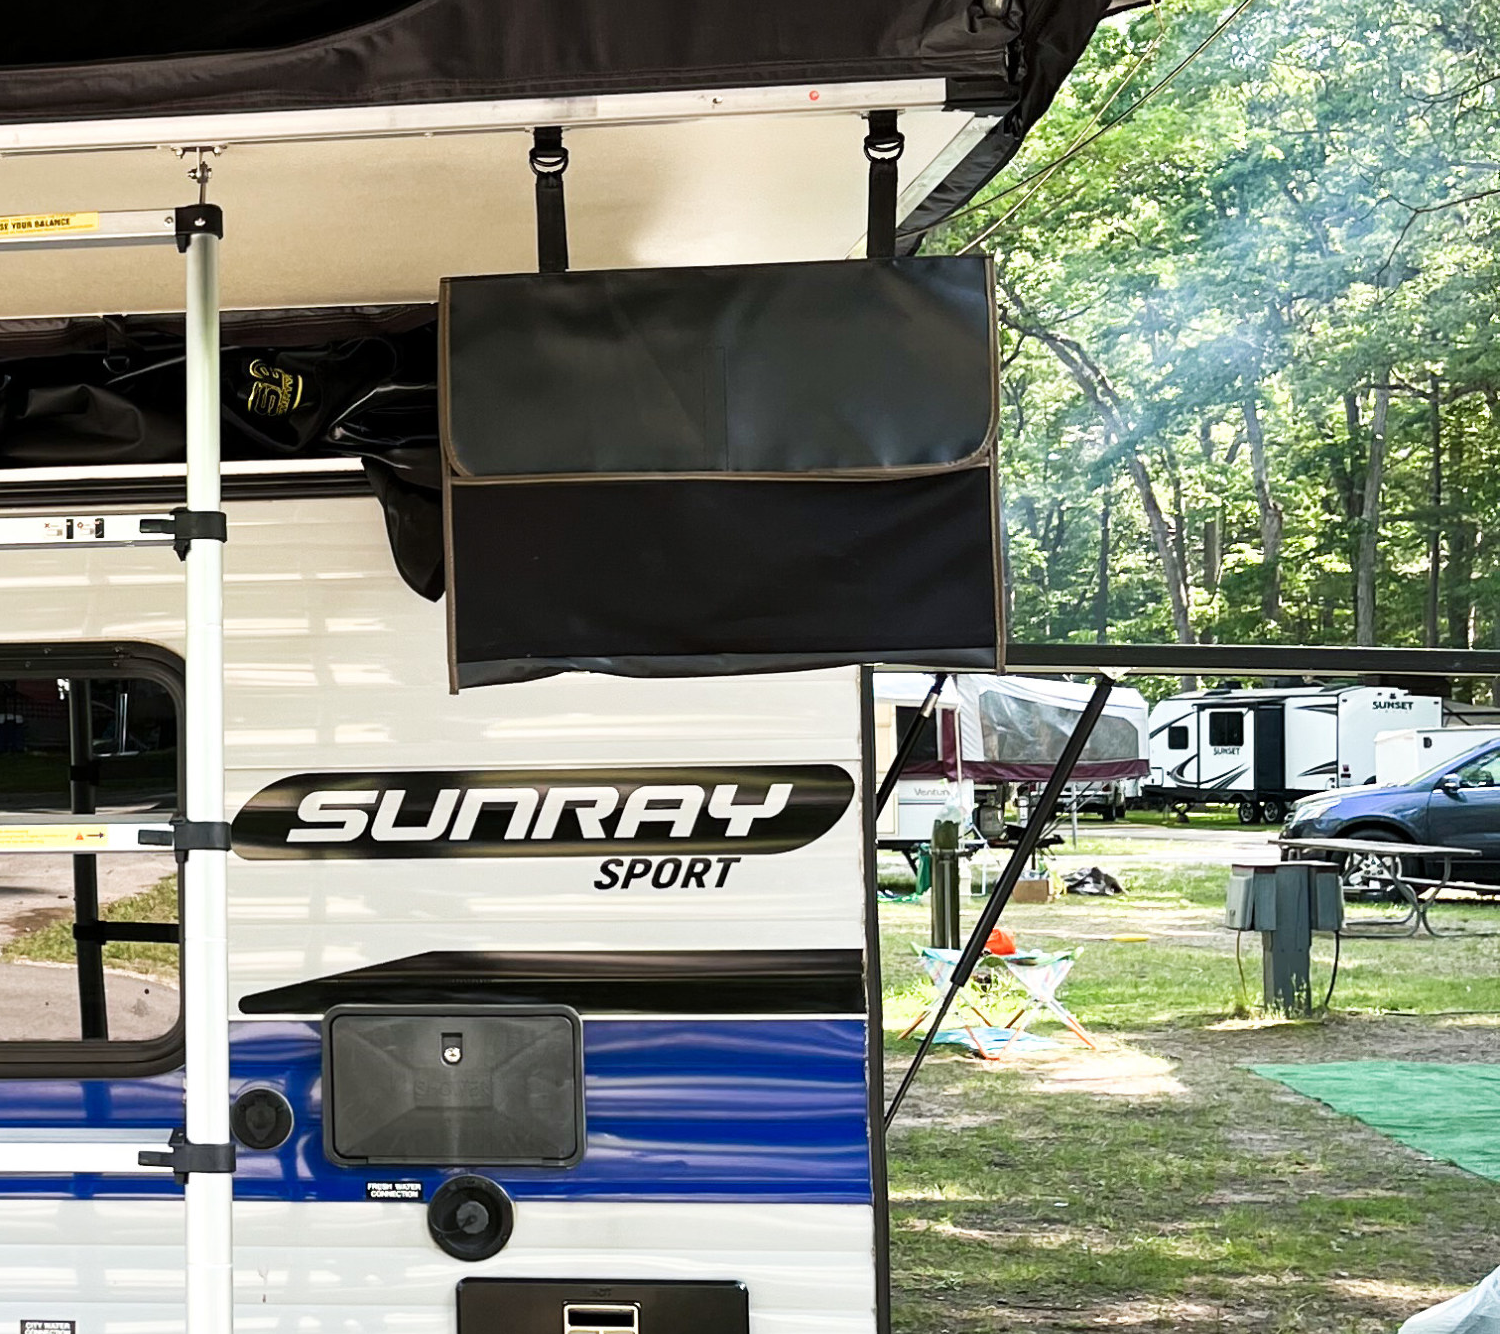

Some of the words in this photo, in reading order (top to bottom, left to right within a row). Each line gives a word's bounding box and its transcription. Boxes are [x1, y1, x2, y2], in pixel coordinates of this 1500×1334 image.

[11, 221, 32, 229] YOUR
[34, 218, 70, 228] BALANCE
[1372, 701, 1414, 710] SUNSET
[286, 783, 794, 843] SUNRAY
[594, 857, 741, 890] SPORT
[367, 1183, 393, 1191] FRESH
[394, 1183, 422, 1191] WATER
[370, 1190, 419, 1198] CONNECTION
